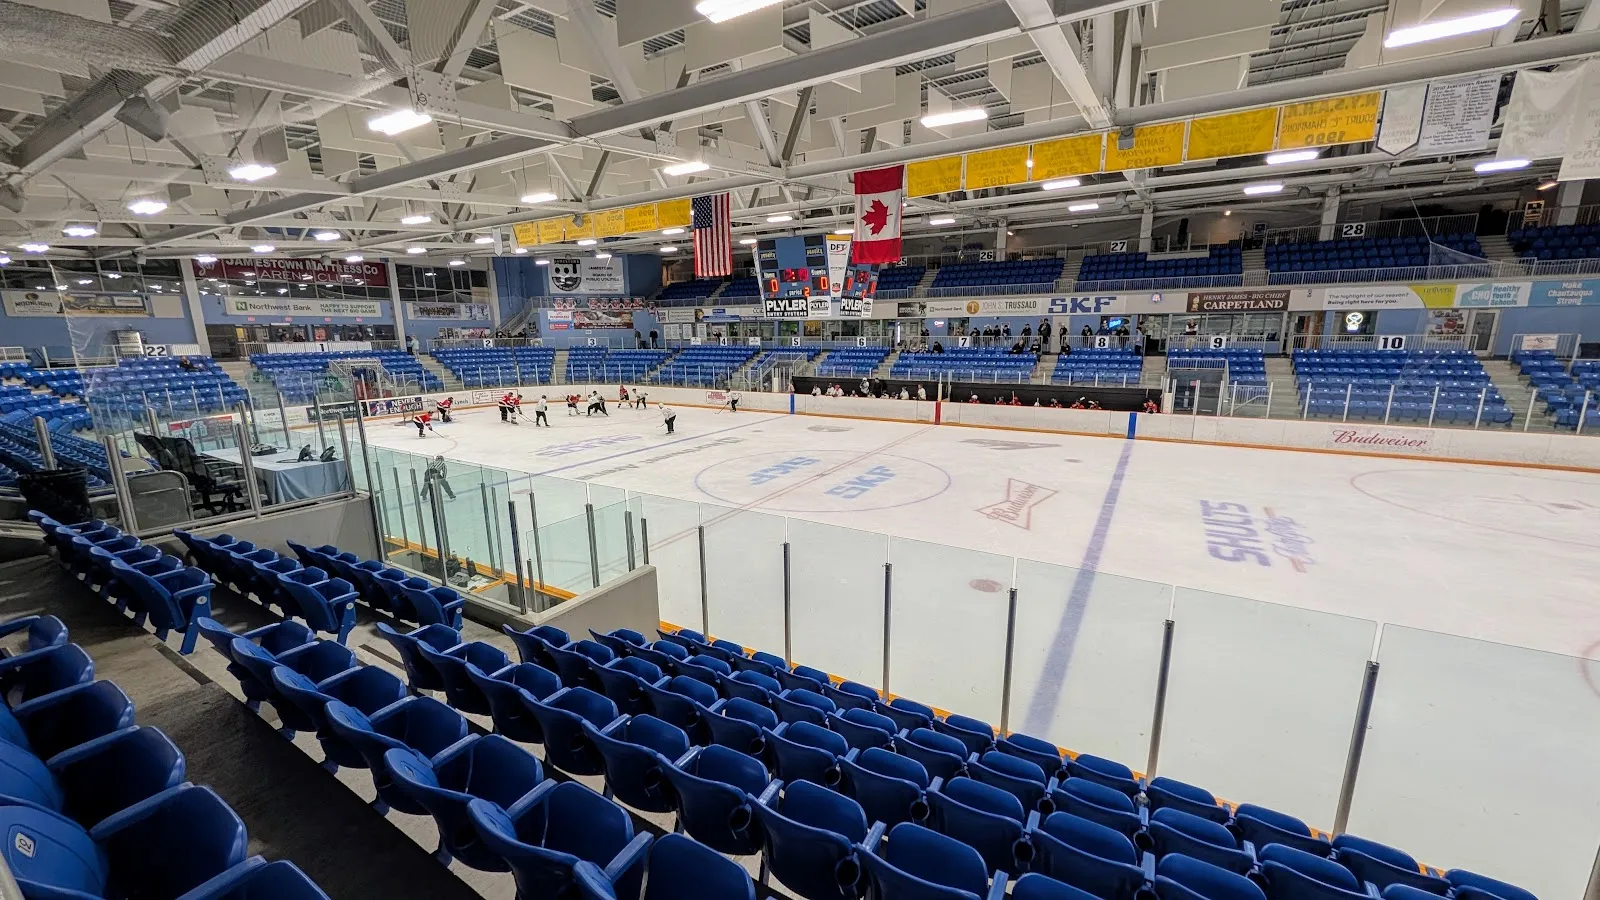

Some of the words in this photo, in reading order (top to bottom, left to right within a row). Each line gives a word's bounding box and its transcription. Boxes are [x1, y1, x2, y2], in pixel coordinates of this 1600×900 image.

[1343, 224, 1364, 235] 28
[1111, 242, 1126, 251] 27
[981, 251, 993, 260] 26
[226, 258, 304, 271] JAMESTOWN
[305, 260, 362, 274] MATTRESS
[771, 279, 778, 292] 0
[821, 277, 828, 290] 0
[804, 287, 810, 297] 2
[1493, 285, 1521, 293] Healthy
[1548, 290, 1593, 298] Chautauqua
[249, 303, 291, 311] Northwest
[766, 300, 807, 312] PLYLER
[841, 299, 862, 310] PLYLER
[1005, 301, 1037, 310] TRUSSALO
[1048, 296, 1117, 313] SKF
[1203, 300, 1284, 310] CARPETLAND
[1557, 298, 1583, 306] Strong
[319, 343, 325, 351] 1
[859, 338, 865, 346] 6
[961, 338, 967, 346] 7
[1098, 338, 1106, 347] 8
[1213, 337, 1223, 348] 9
[1382, 337, 1403, 349] 10
[146, 346, 166, 356] 22
[391, 397, 416, 406] NEVER
[1332, 430, 1427, 447] Budweiser
[824, 465, 897, 500] SKF
[18, 838, 32, 853] 12
